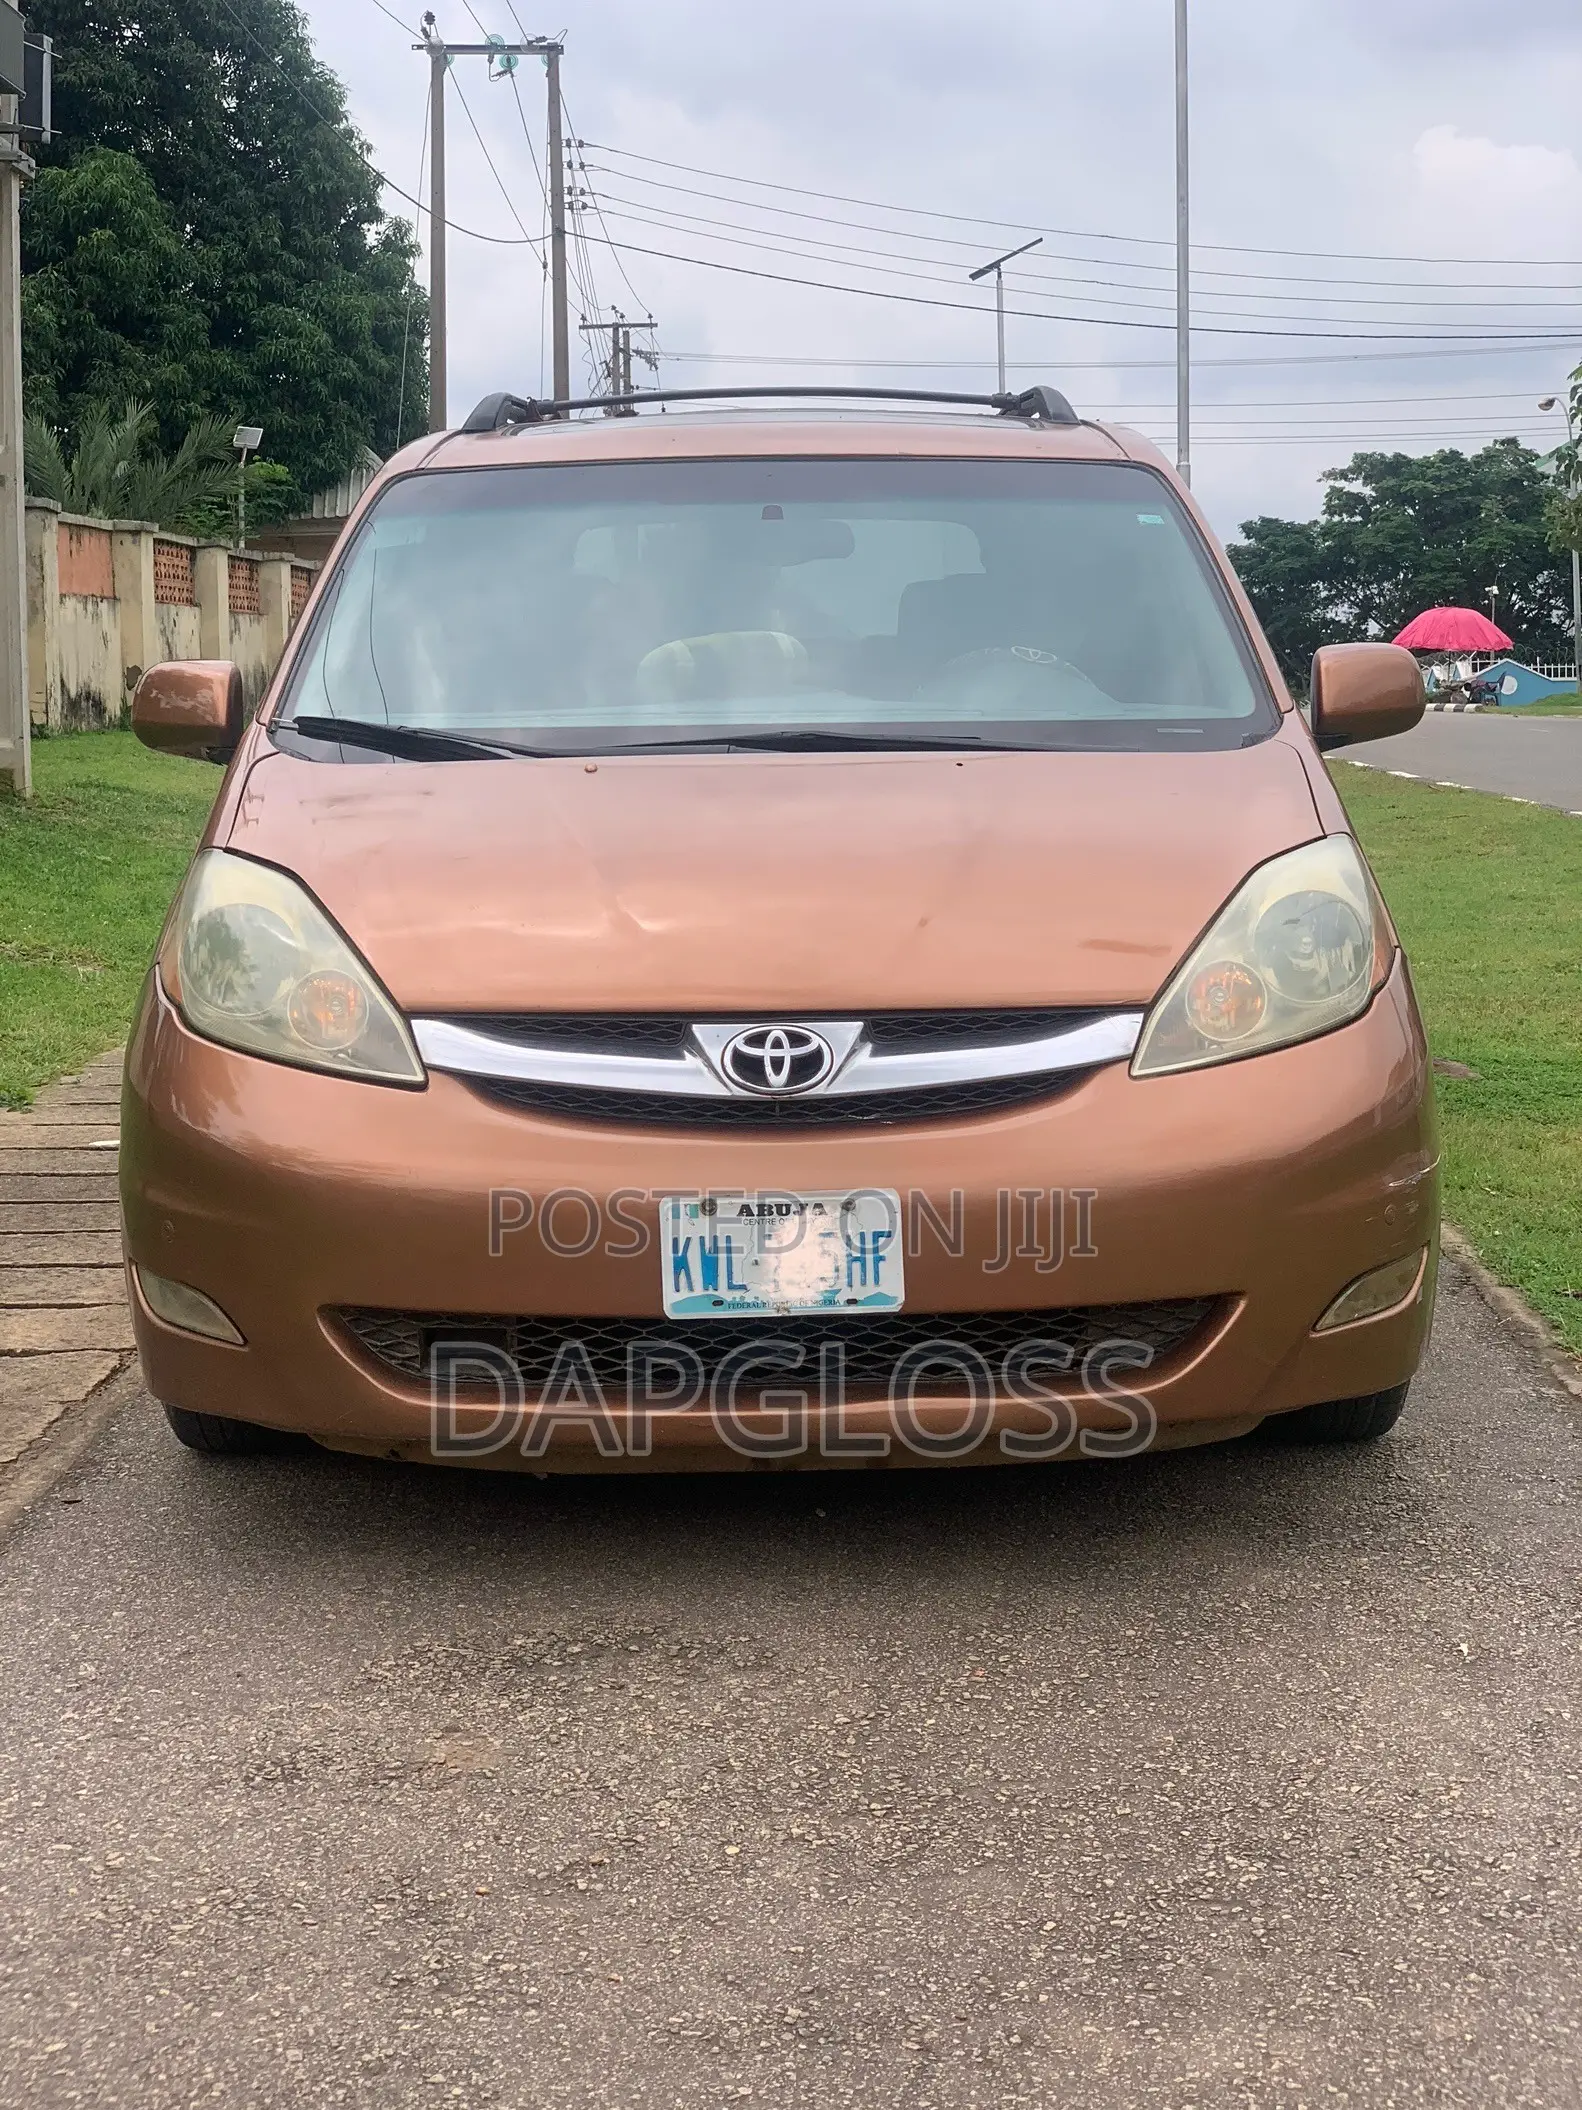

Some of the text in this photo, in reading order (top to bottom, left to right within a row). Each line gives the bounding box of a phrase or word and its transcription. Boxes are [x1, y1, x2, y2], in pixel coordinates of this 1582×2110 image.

[737, 1202, 828, 1217] ABUJA
[743, 1218, 776, 1226] CENTRE
[672, 1234, 748, 1293] KWL
[728, 1301, 761, 1310] FEDERAL
